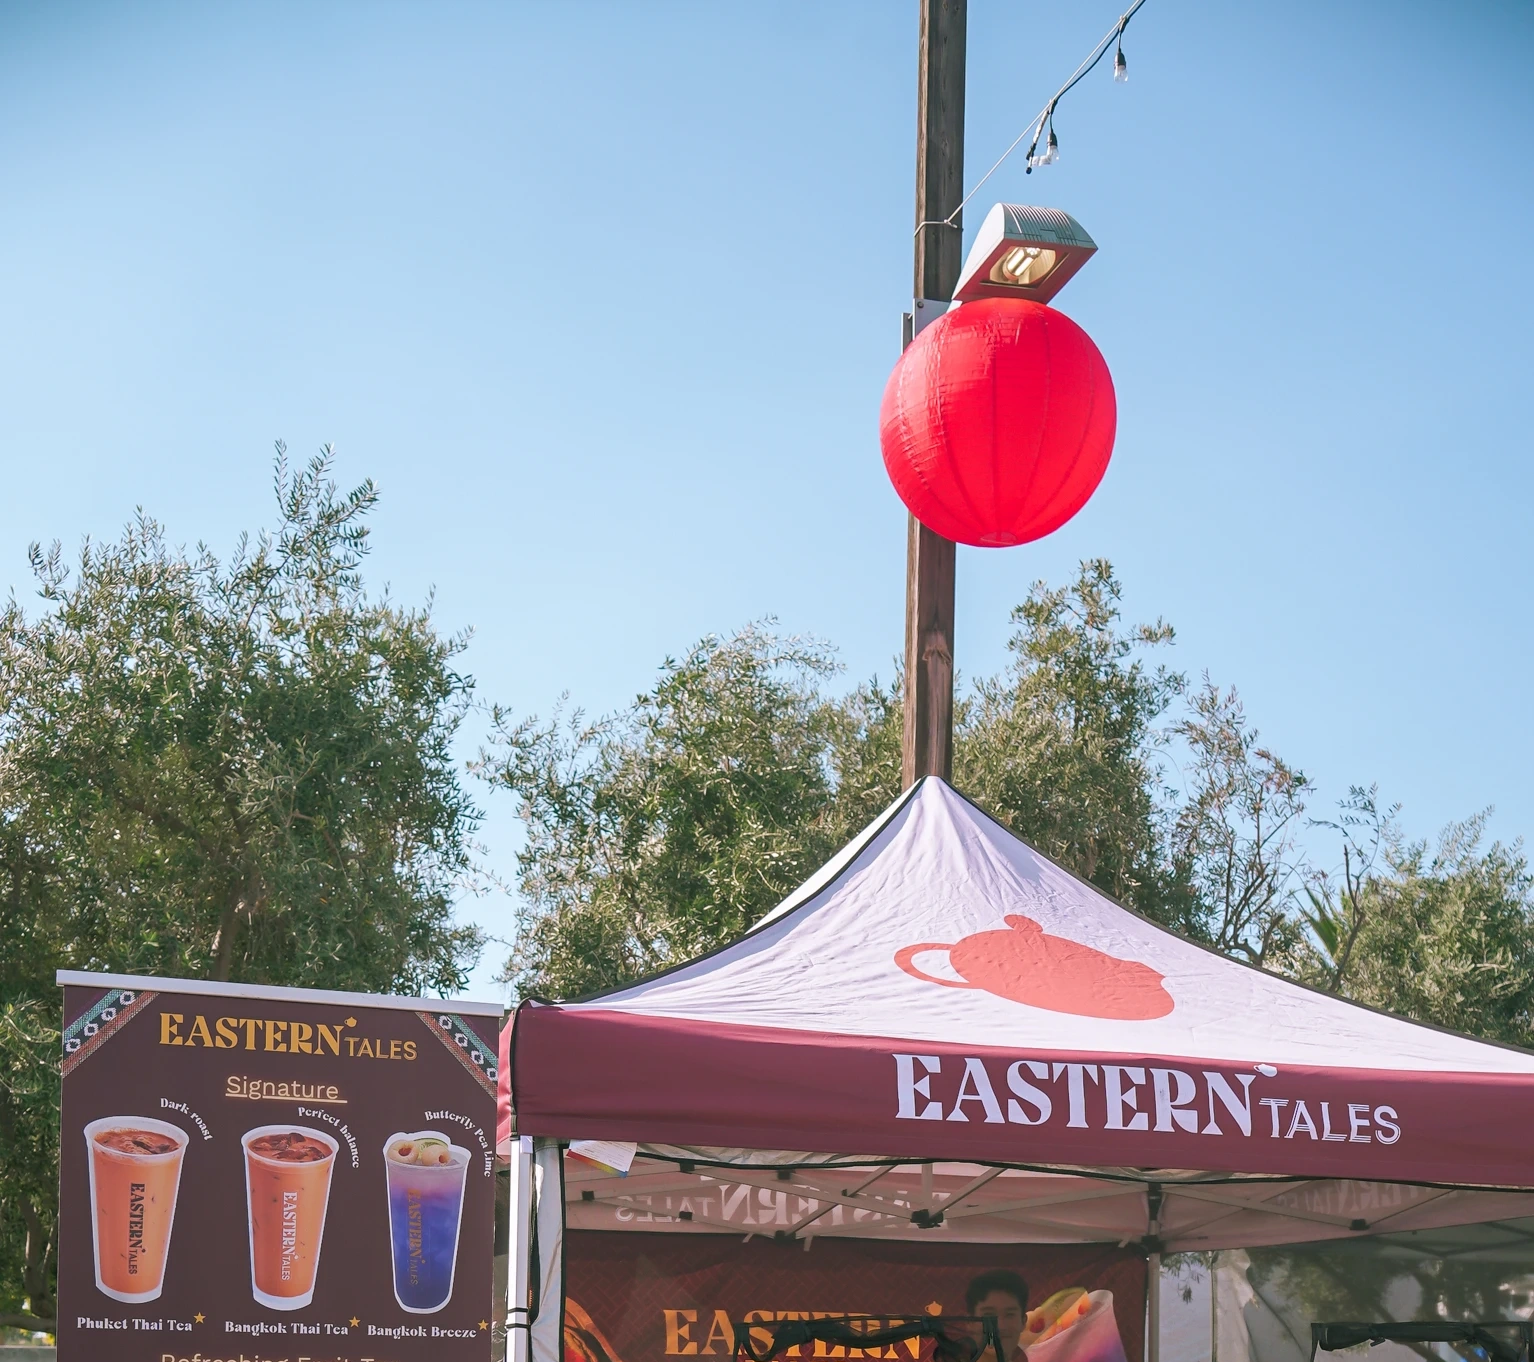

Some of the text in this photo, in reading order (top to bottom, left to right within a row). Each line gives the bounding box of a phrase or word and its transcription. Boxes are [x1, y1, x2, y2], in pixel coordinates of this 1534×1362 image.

[159, 1012, 418, 1061] EASTERN TALES
[226, 1075, 339, 1100] Signature
[891, 1053, 1401, 1145] EASTERN TALES
[424, 1110, 494, 1178] Butterfly Pea Lime
[128, 1182, 145, 1275] EASTERN TALES
[281, 1192, 298, 1281] EASTERN TALES
[76, 1316, 193, 1332] Phuket Thai Tea
[225, 1320, 349, 1336] Bangkok Thai Tea
[367, 1324, 477, 1340] Bangkok Breeze
